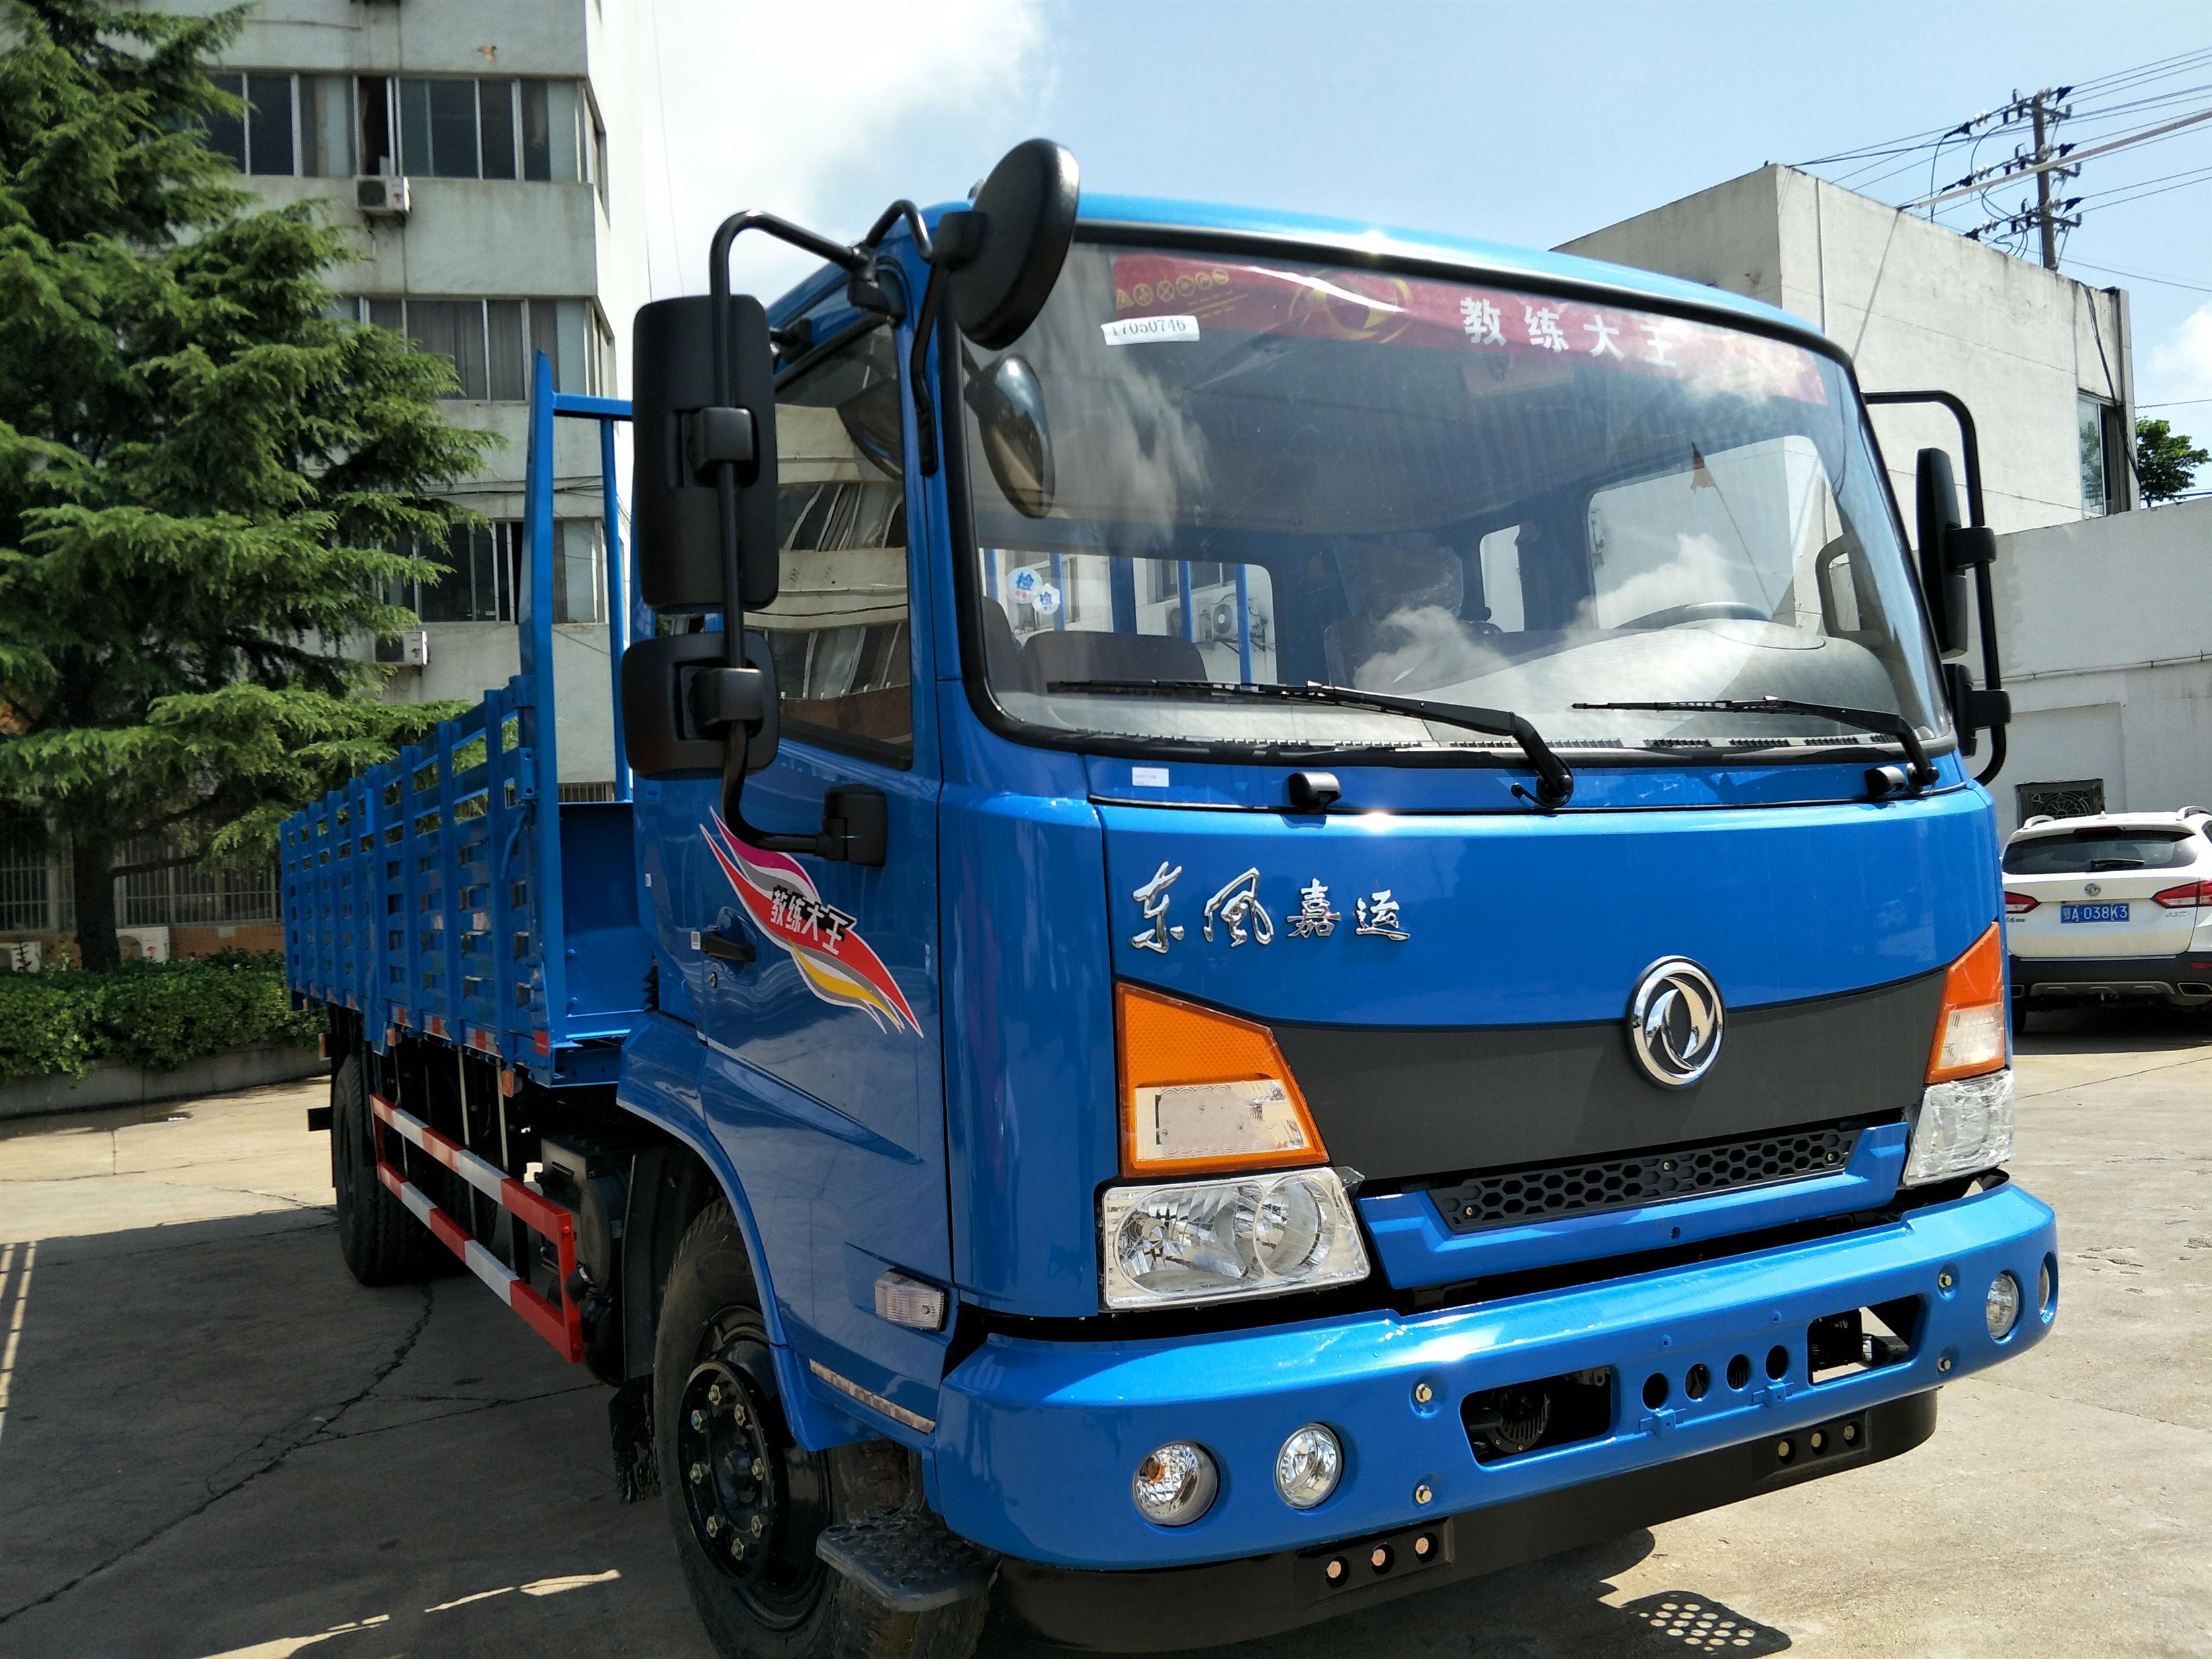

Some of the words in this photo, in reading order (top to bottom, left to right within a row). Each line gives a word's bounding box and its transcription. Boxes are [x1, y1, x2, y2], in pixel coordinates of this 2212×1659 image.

[1460, 296, 1677, 367] 教练大王
[770, 889, 849, 956] 教练大王
[1132, 861, 1410, 953] 东风嘉运
